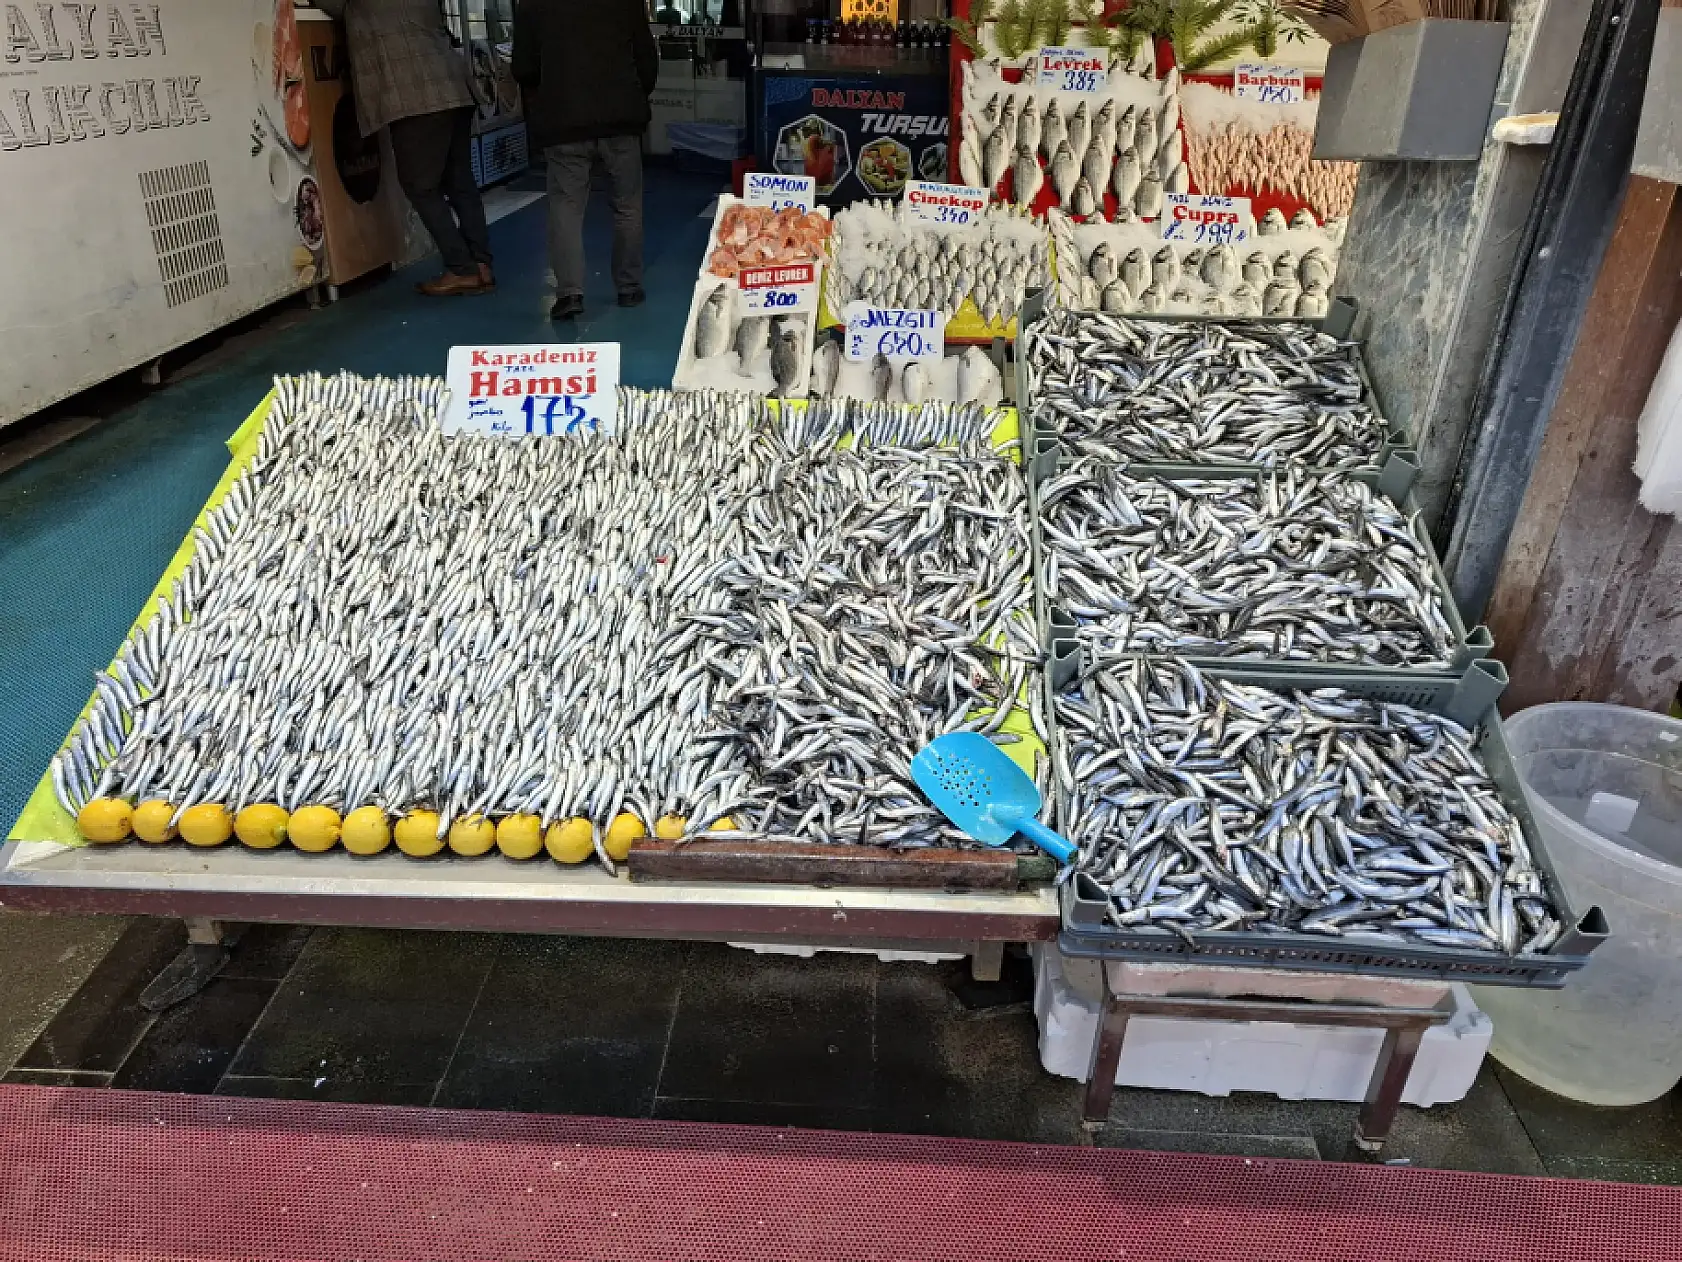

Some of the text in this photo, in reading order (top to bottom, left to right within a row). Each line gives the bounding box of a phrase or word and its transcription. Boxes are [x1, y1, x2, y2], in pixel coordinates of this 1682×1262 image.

[1042, 56, 1105, 71] Levrek
[1238, 73, 1302, 88] Barbun
[810, 87, 906, 111] DALYAN
[748, 174, 809, 191] SOMON
[763, 290, 798, 308] 800
[471, 348, 598, 366] Karadeniz
[469, 367, 598, 398] Hamsi
[520, 394, 593, 436] 175
